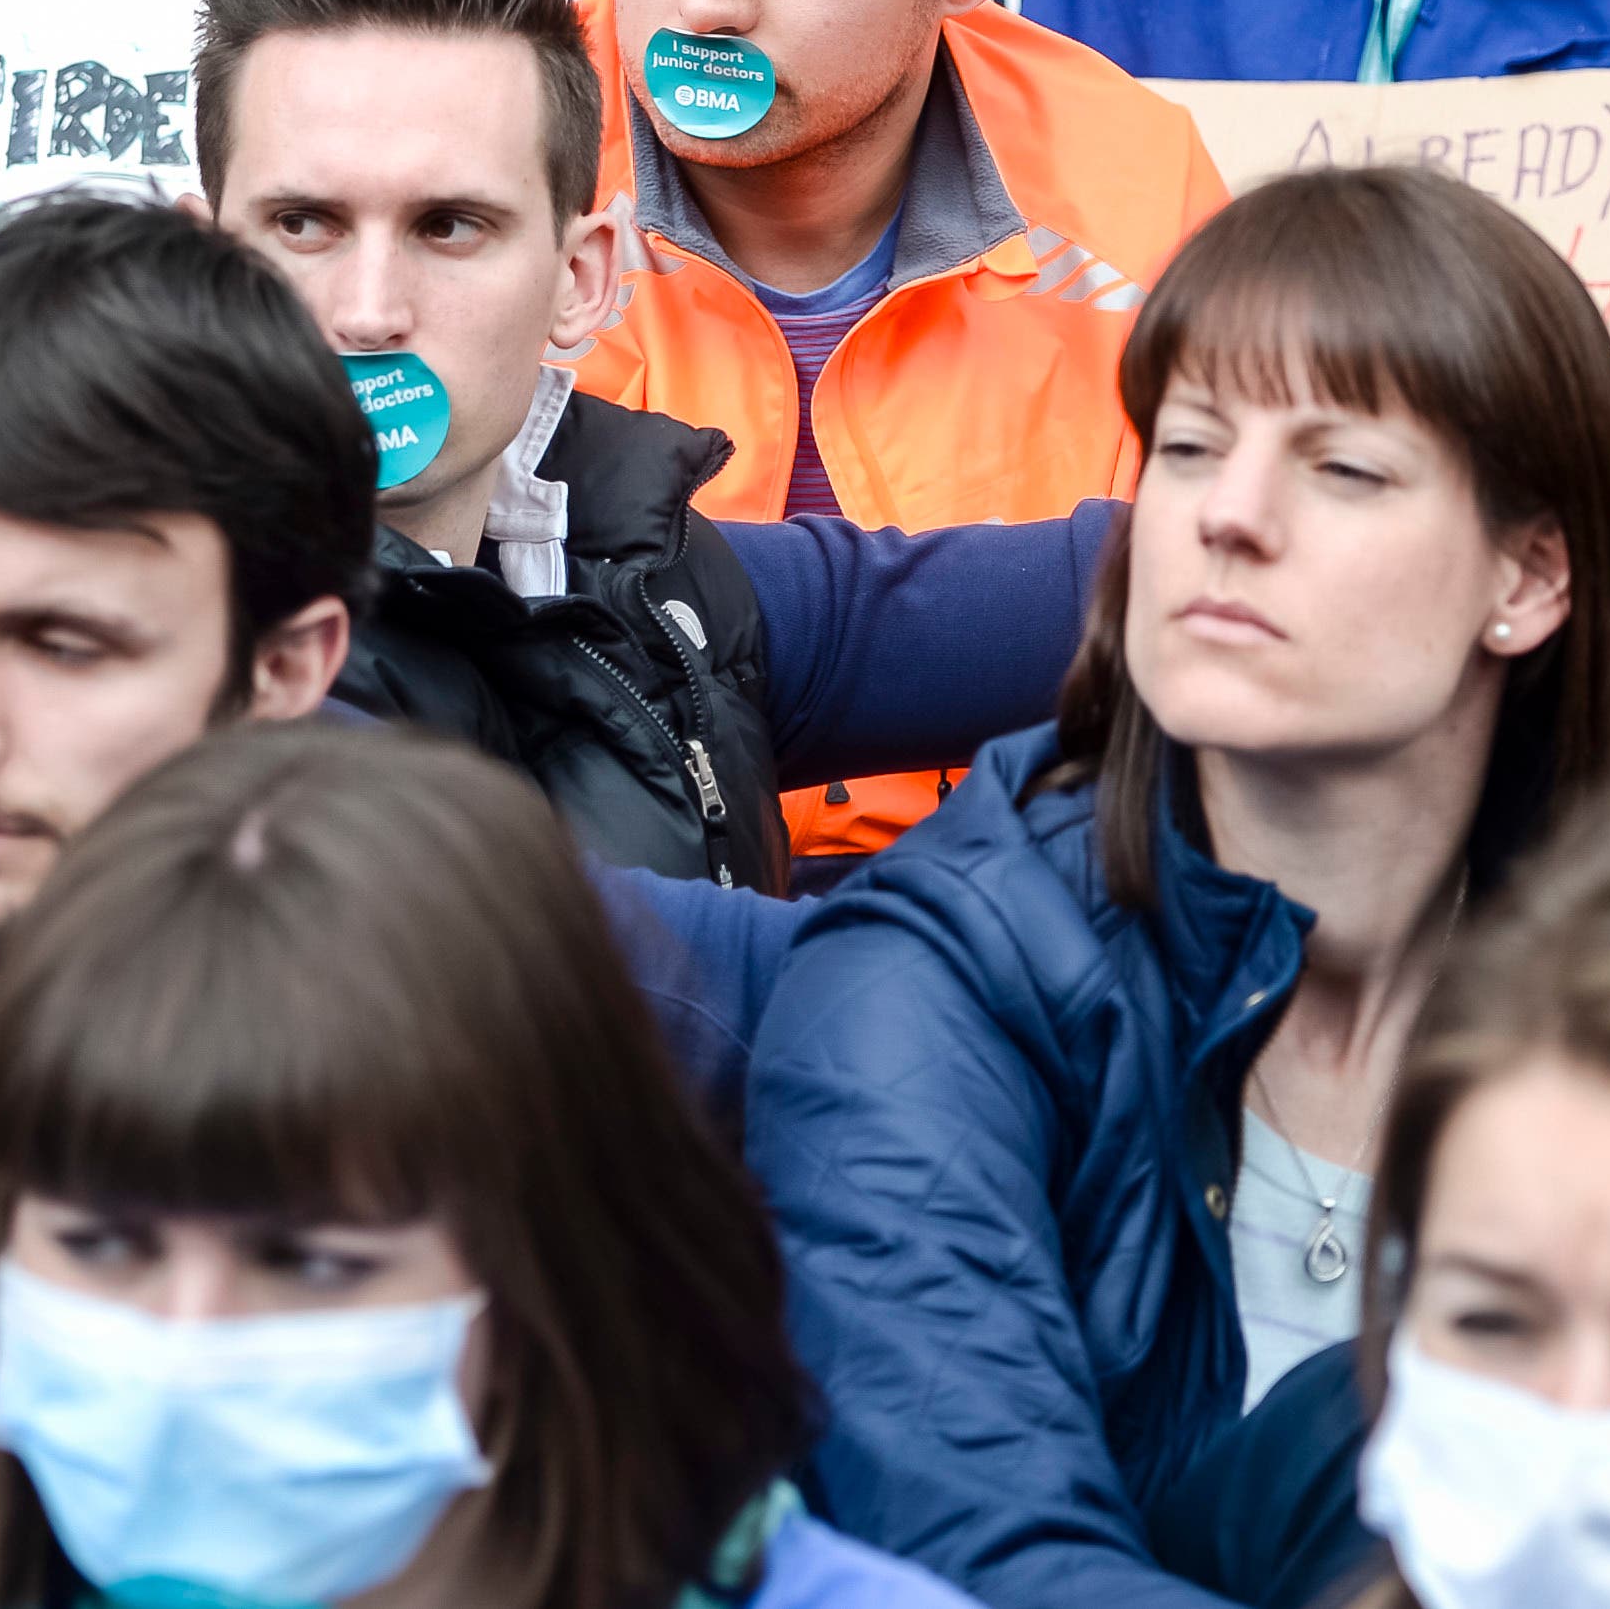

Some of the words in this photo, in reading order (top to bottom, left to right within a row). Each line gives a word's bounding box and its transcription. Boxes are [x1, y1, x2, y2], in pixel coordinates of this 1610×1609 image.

[652, 51, 700, 71] junior
[703, 61, 765, 82] doctors
[672, 39, 678, 52] I
[681, 43, 744, 64] support
[695, 88, 741, 112] BMA
[351, 367, 406, 399] pport
[360, 383, 435, 415] doctors
[375, 424, 420, 453] MA
